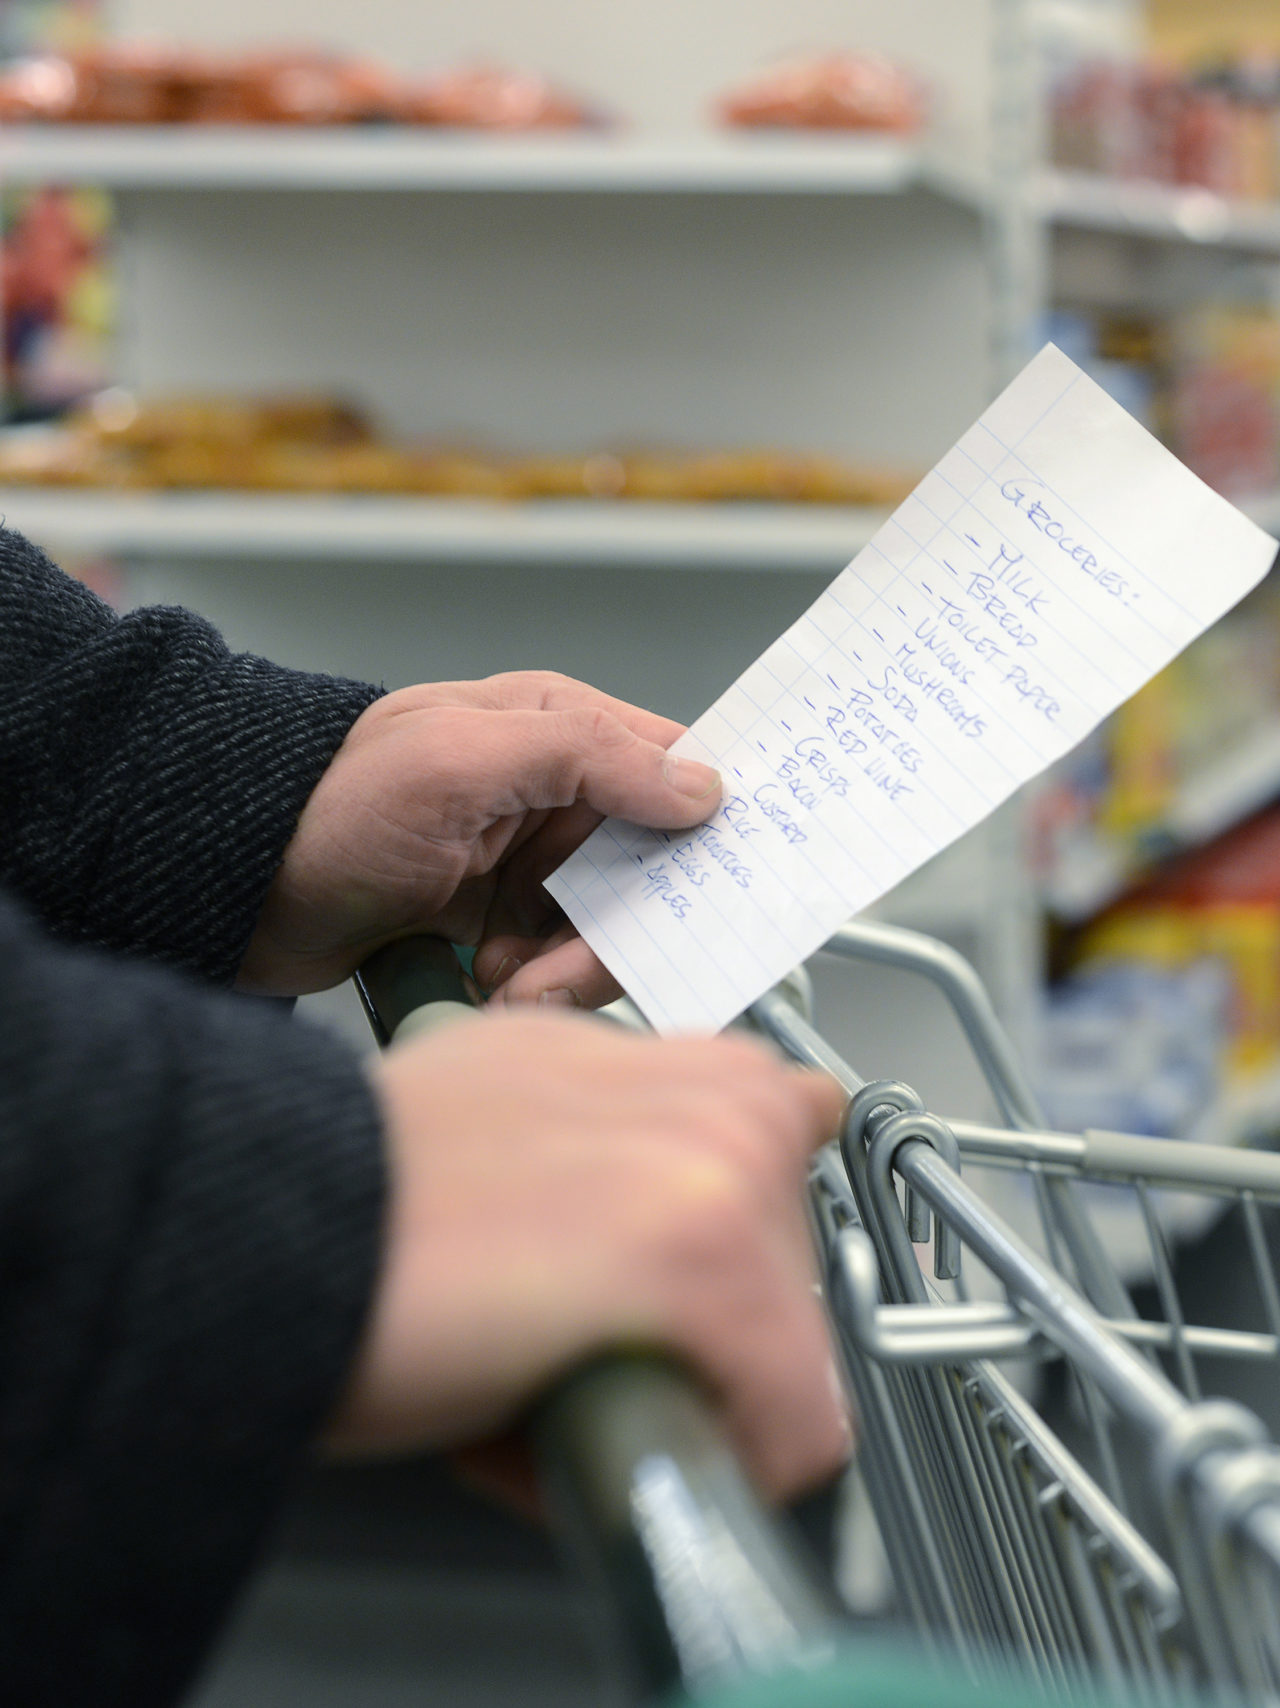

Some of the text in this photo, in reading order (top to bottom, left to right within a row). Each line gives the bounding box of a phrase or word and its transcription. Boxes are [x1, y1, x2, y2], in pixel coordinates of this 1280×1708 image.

[1001, 478, 1140, 607] GROCERIES:
[988, 543, 1049, 615] MILK
[938, 595, 1009, 663] TOILET
[825, 705, 868, 755] RED
